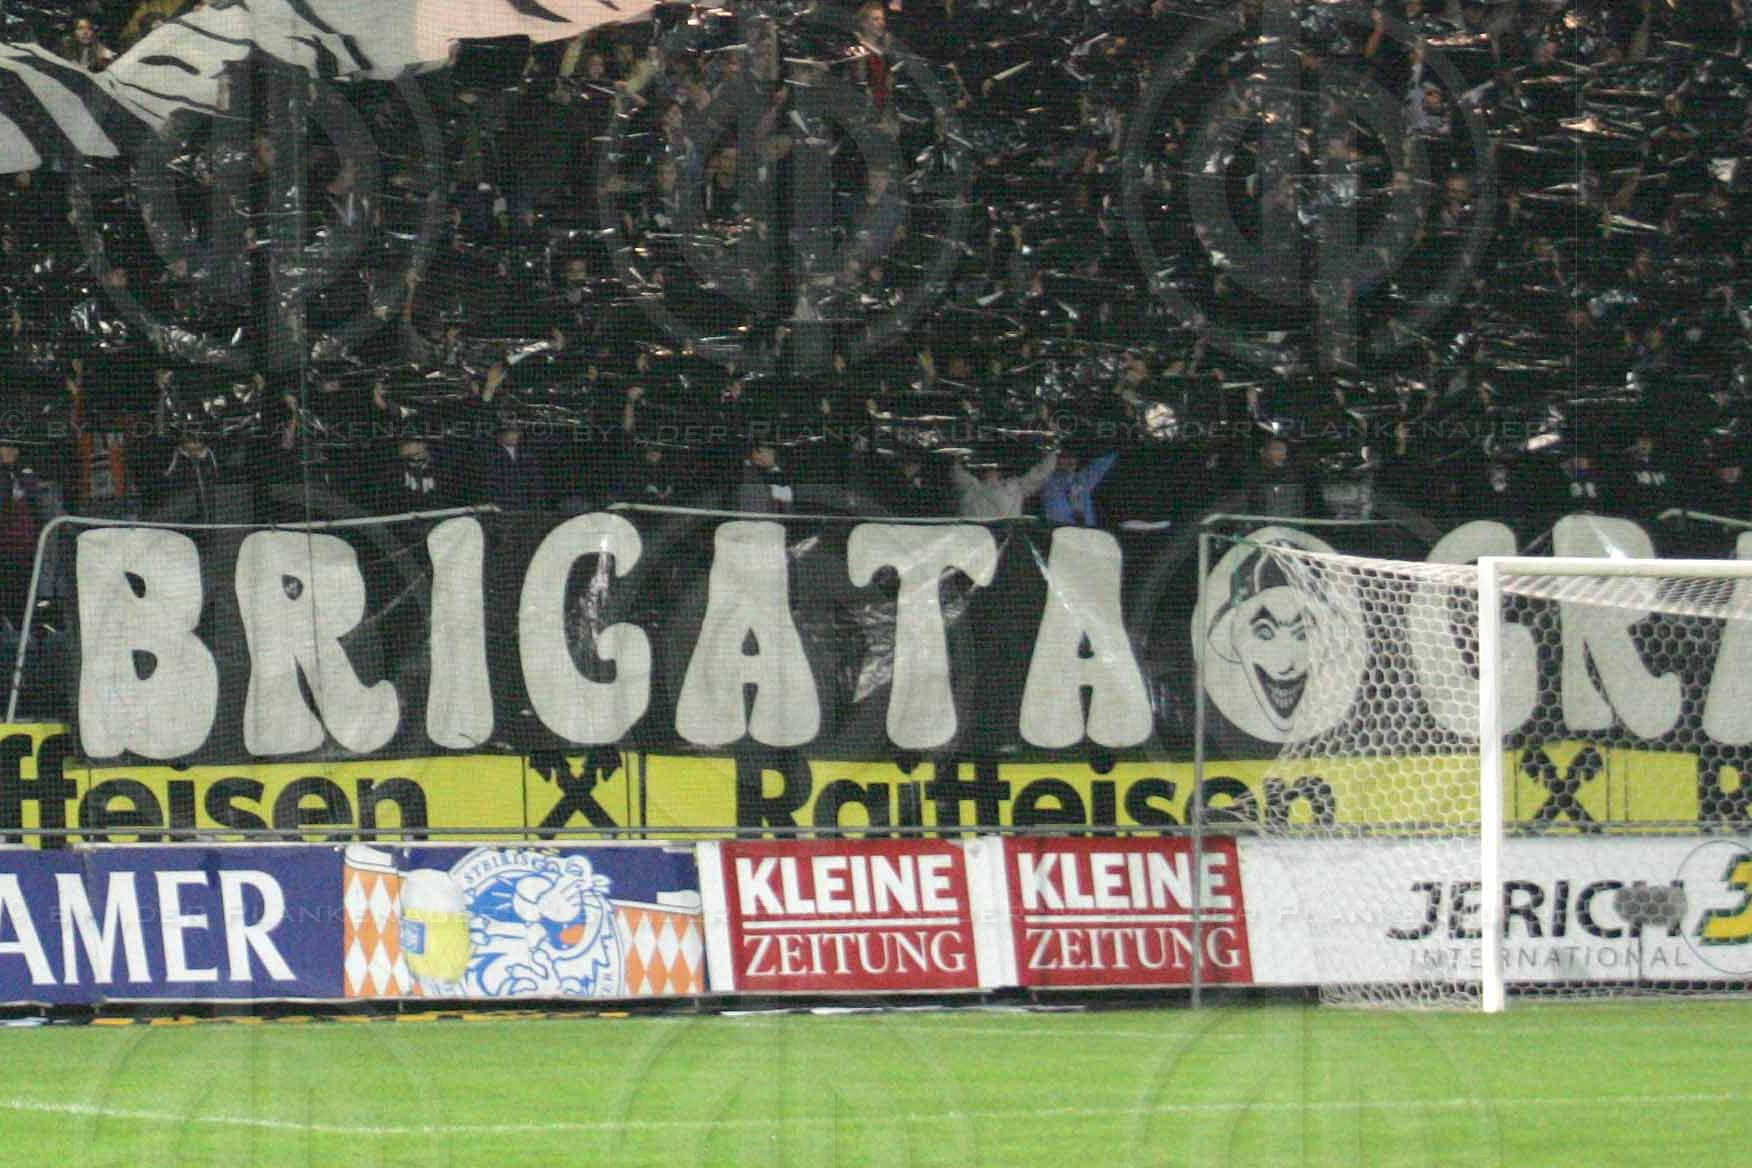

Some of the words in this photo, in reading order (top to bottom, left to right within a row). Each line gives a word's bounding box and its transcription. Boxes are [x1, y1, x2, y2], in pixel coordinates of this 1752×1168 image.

[76, 511, 1154, 761] BRIGATA
[735, 854, 961, 914] KLEINE
[1016, 851, 1233, 910] KLEINE
[744, 930, 967, 978] ZEITUNG
[1025, 927, 1241, 970] ZEITUNG
